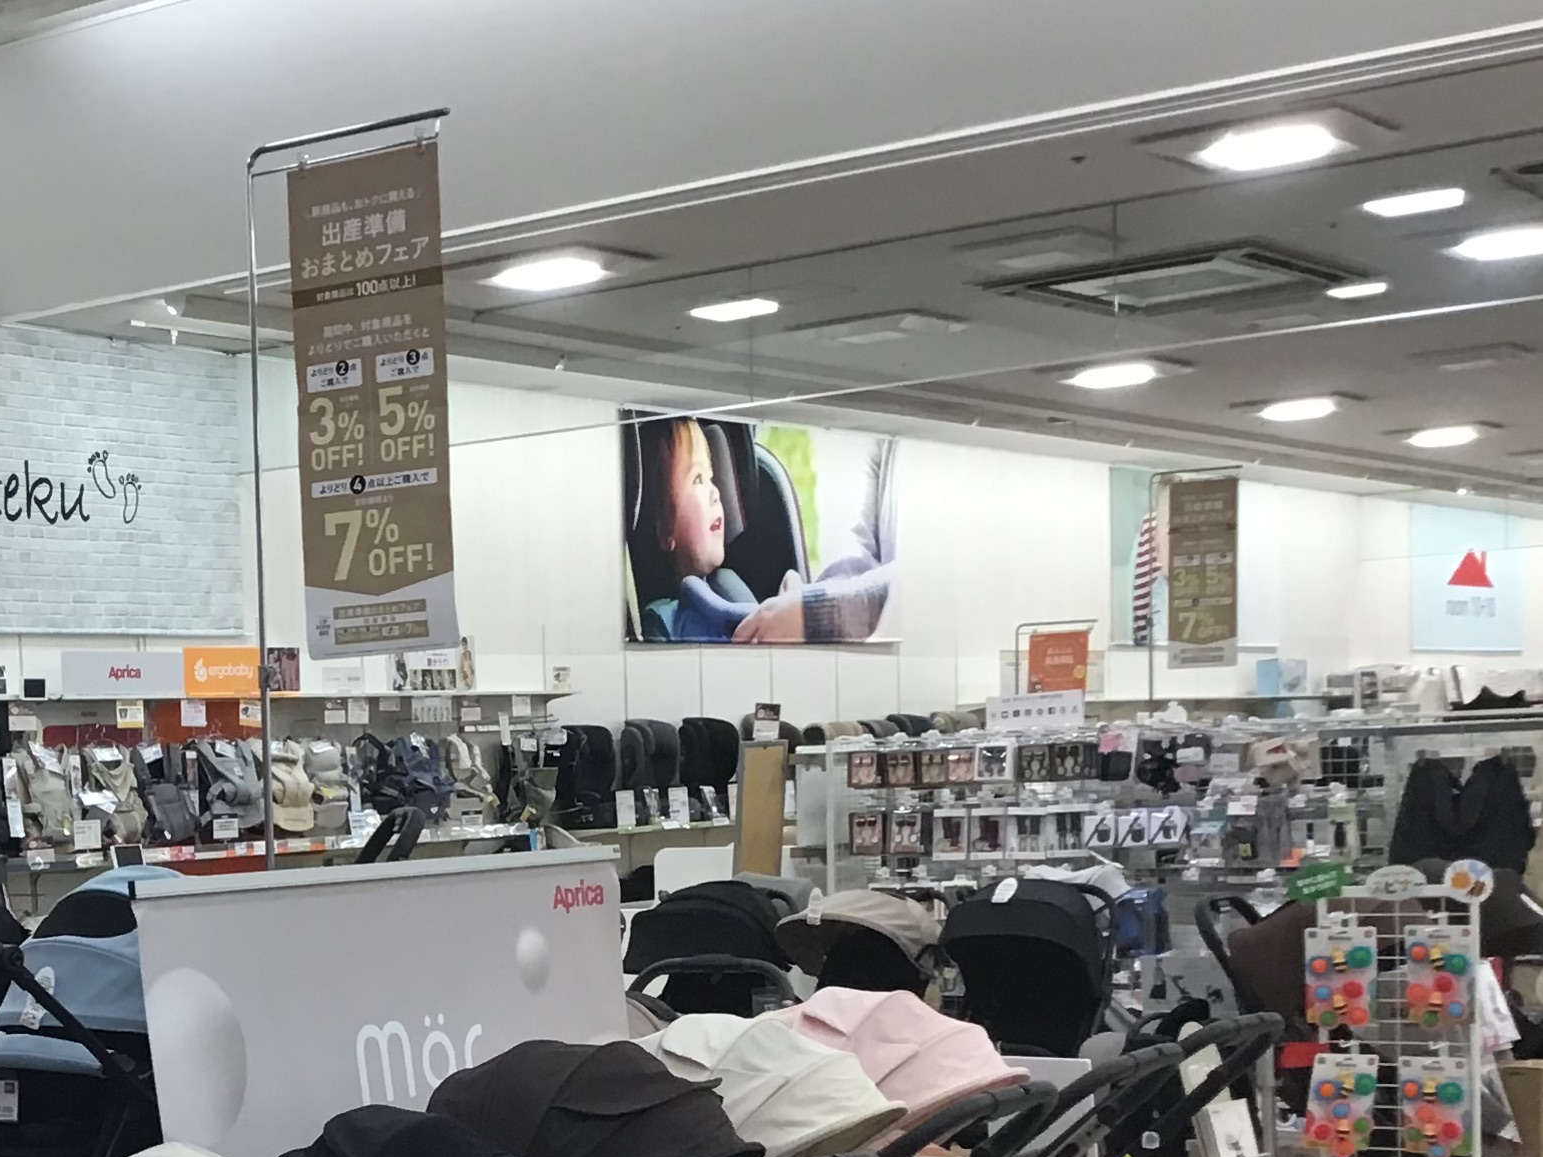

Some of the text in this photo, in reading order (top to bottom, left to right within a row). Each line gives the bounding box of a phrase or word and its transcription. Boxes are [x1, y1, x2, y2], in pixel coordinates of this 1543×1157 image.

[322, 209, 406, 246] 出産準備
[301, 236, 429, 279] おまとめフェア
[309, 397, 365, 445] 3%
[378, 386, 436, 436] 5%
[311, 444, 363, 471] OFF!
[380, 435, 435, 462] OFF!
[324, 507, 399, 582] 7%
[368, 542, 433, 576] OFF!
[109, 665, 142, 681] Aprica
[209, 662, 254, 679] ergobaby
[553, 880, 605, 913] Aprica
[356, 1013, 483, 1106] mör
